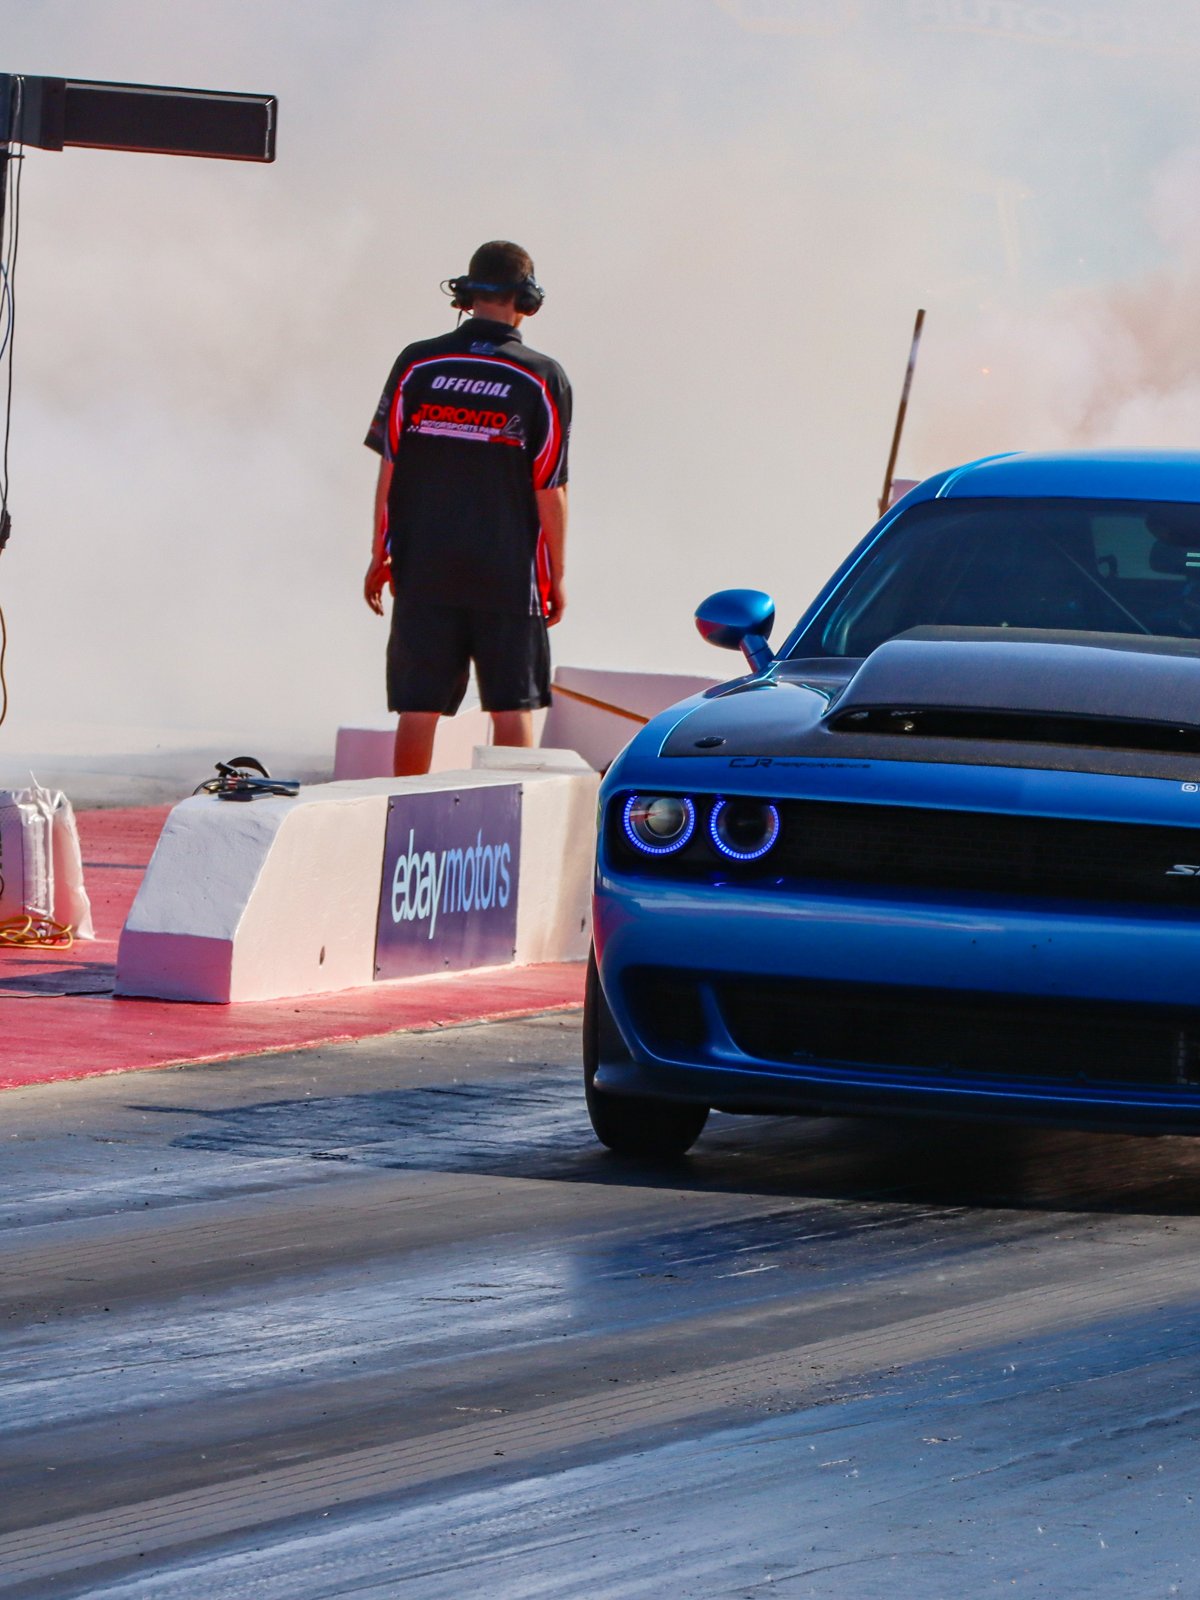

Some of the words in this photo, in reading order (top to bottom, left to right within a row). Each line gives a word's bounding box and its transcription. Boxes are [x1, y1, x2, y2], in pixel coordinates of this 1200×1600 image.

[431, 375, 511, 397] OFFICIAL
[420, 404, 508, 429] TORONTO
[420, 420, 478, 432] MOTORSPORTS
